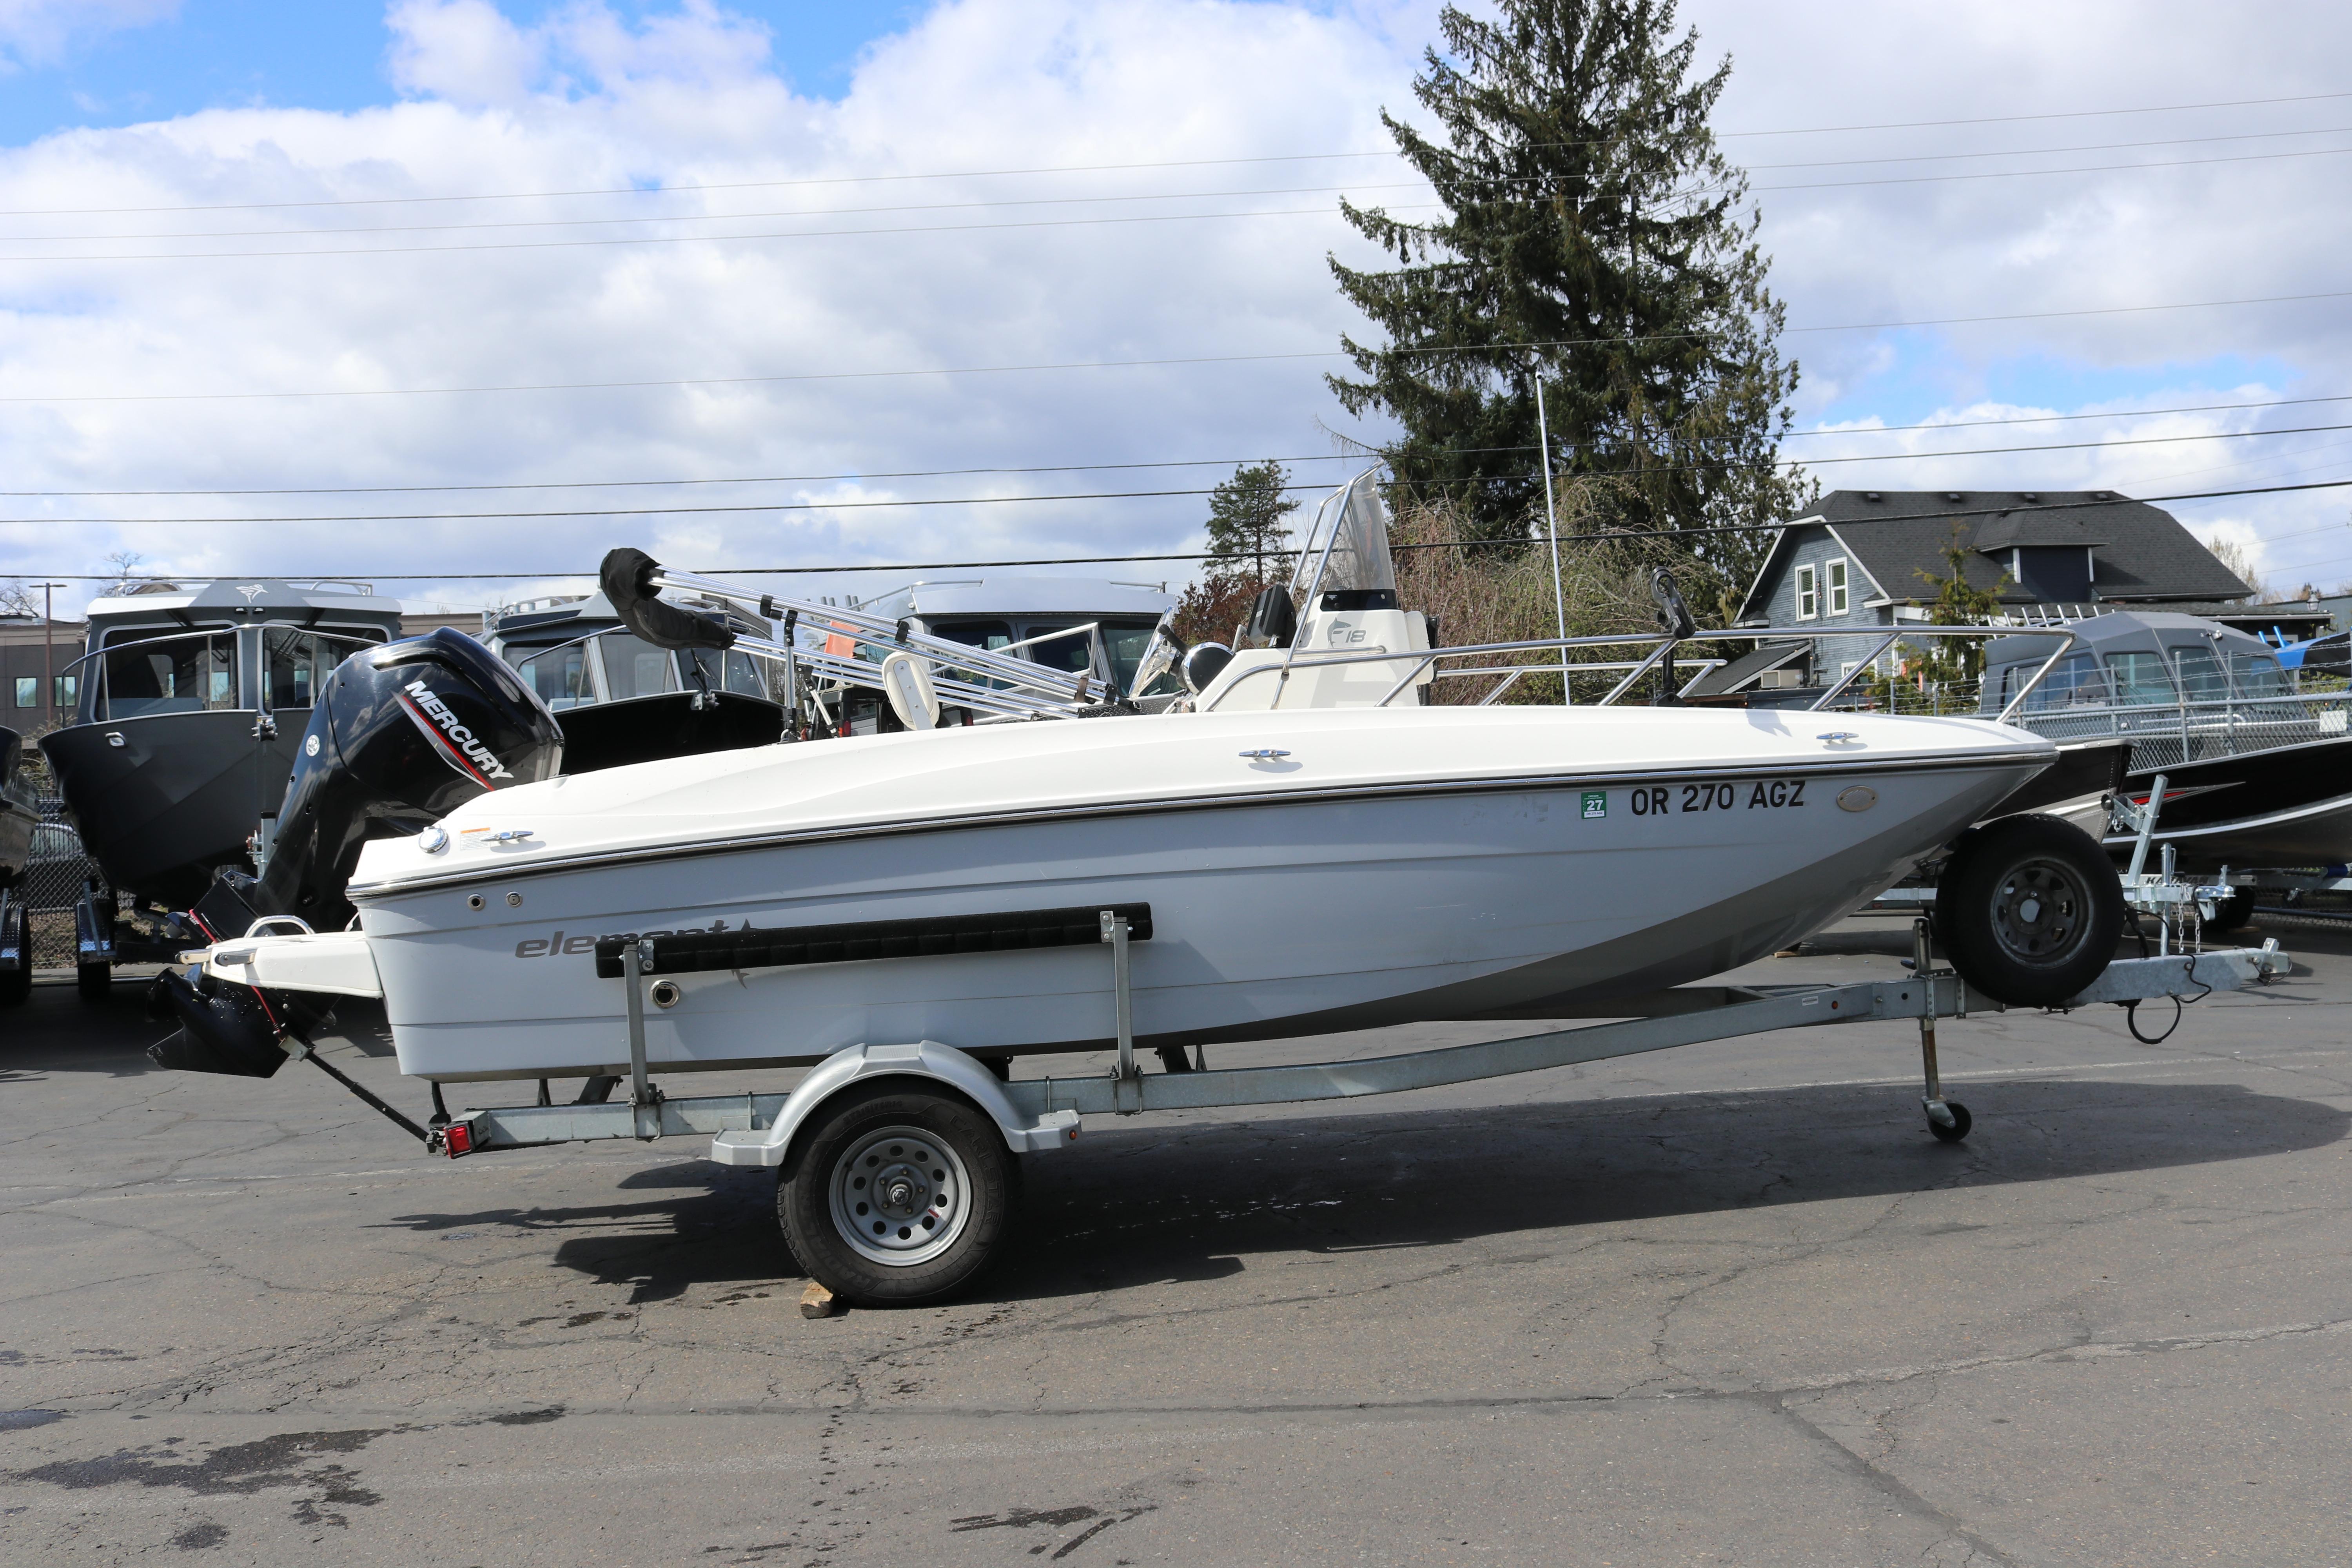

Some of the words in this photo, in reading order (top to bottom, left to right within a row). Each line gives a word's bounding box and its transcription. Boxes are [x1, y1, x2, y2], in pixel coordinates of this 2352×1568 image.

[404, 680, 514, 779] MERCURY
[1586, 800, 1603, 811] 27
[1632, 788, 1669, 816] OR
[1682, 783, 1734, 813] 270
[1748, 780, 1806, 809] AGZ
